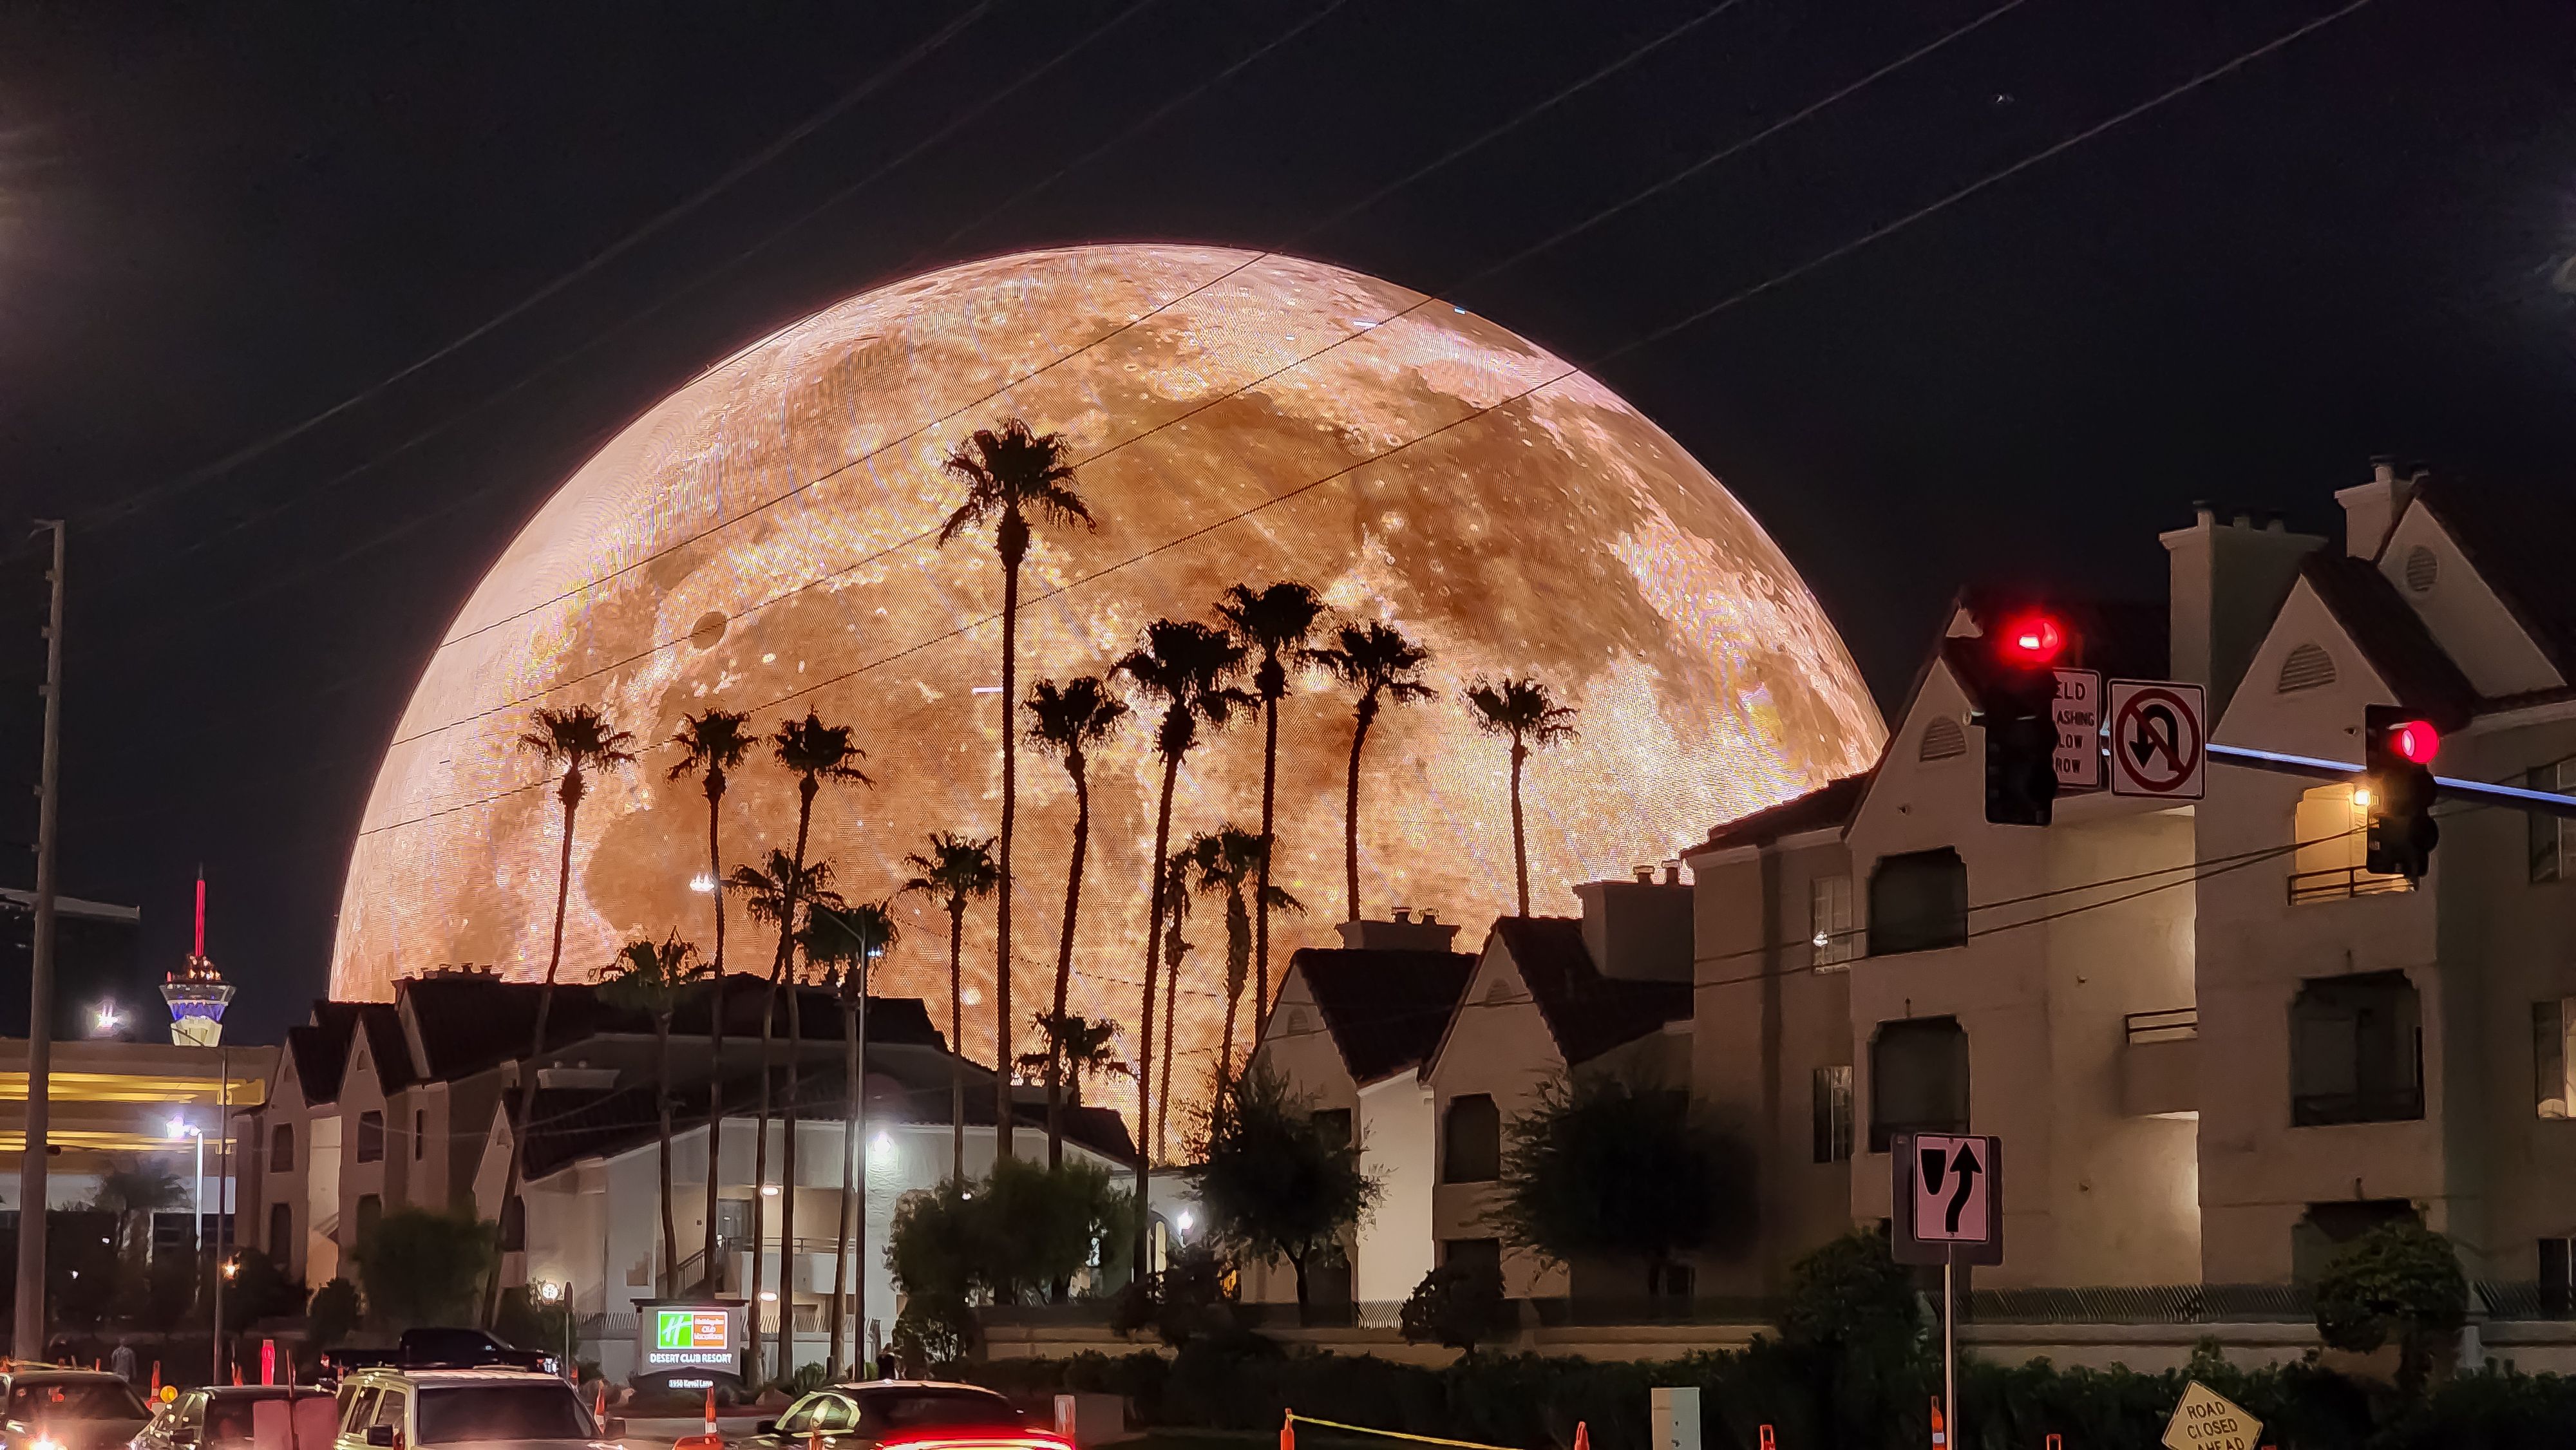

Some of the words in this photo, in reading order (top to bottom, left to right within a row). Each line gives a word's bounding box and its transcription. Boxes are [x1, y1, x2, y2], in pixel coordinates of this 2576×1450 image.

[2057, 710, 2095, 726] ASHING
[2058, 733, 2083, 749] LOW
[2055, 757, 2081, 773] ROW
[650, 1353, 679, 1364] DESERT
[680, 1353, 701, 1363] CLUB
[701, 1353, 732, 1364] RESORT
[2186, 1401, 2226, 1420] ROAD
[2187, 1418, 2238, 1439] CLOSED
